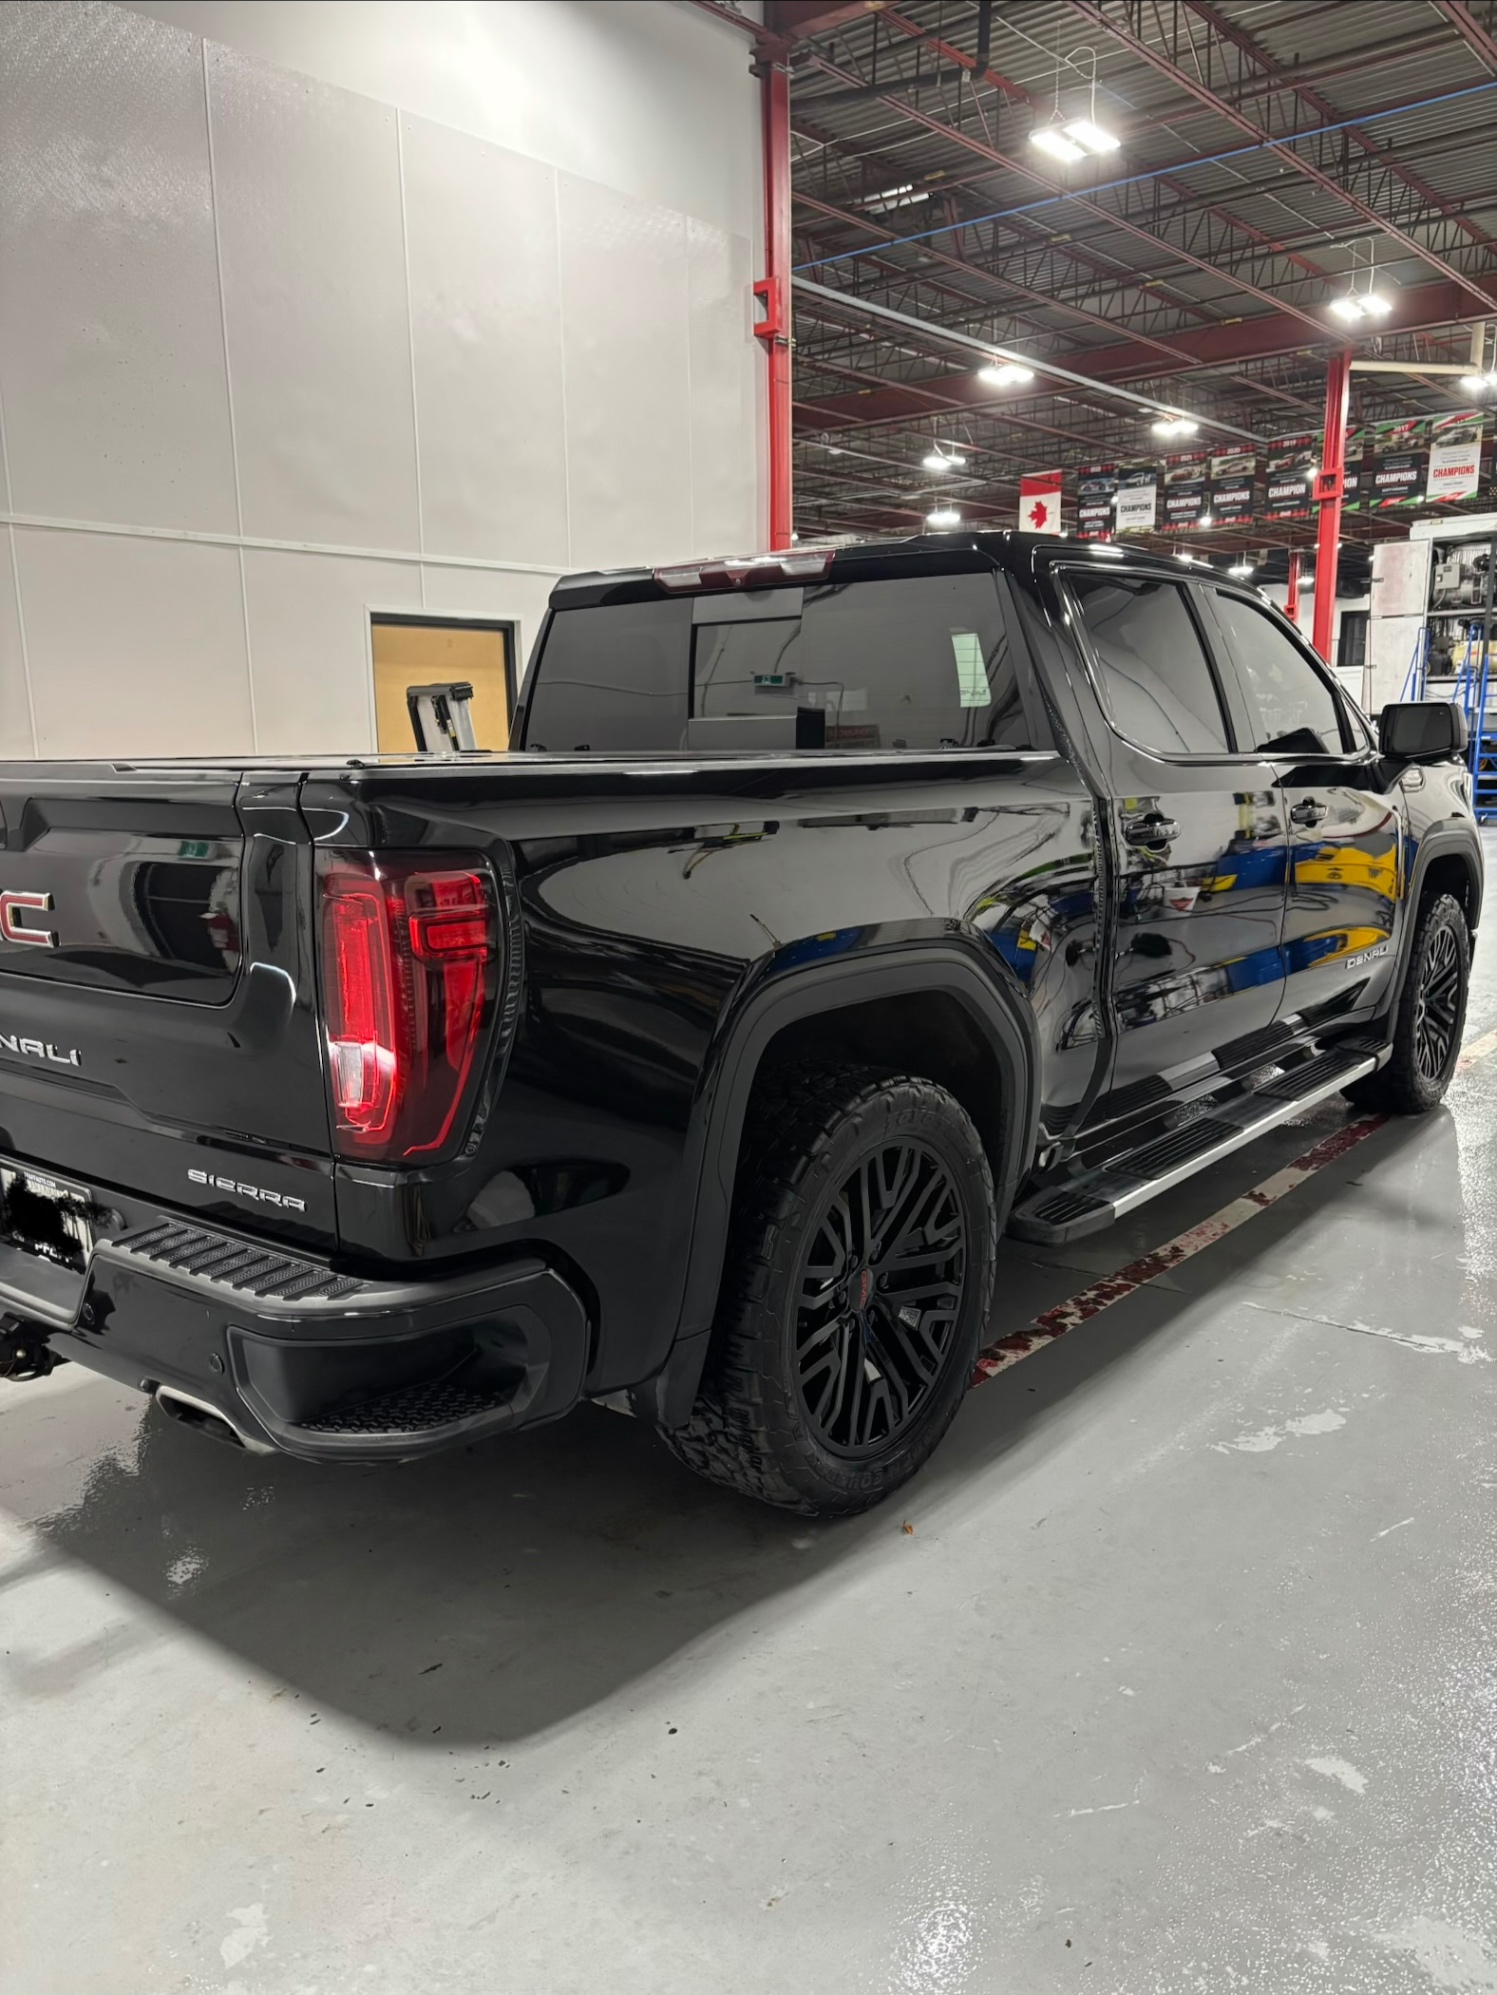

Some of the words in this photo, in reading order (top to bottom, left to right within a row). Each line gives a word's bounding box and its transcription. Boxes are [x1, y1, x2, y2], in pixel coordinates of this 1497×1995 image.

[1375, 470, 1417, 485] CHAMPIONS
[1433, 464, 1475, 479] CHAMPIONS
[1213, 490, 1250, 504] CHAMPIONS
[1268, 483, 1306, 498] CHAMPION
[1120, 503, 1152, 513] CHAMPIONS
[1345, 944, 1389, 969] DENALI
[188, 1168, 306, 1212] SIERRA
[860, 1270, 868, 1310] GMC
